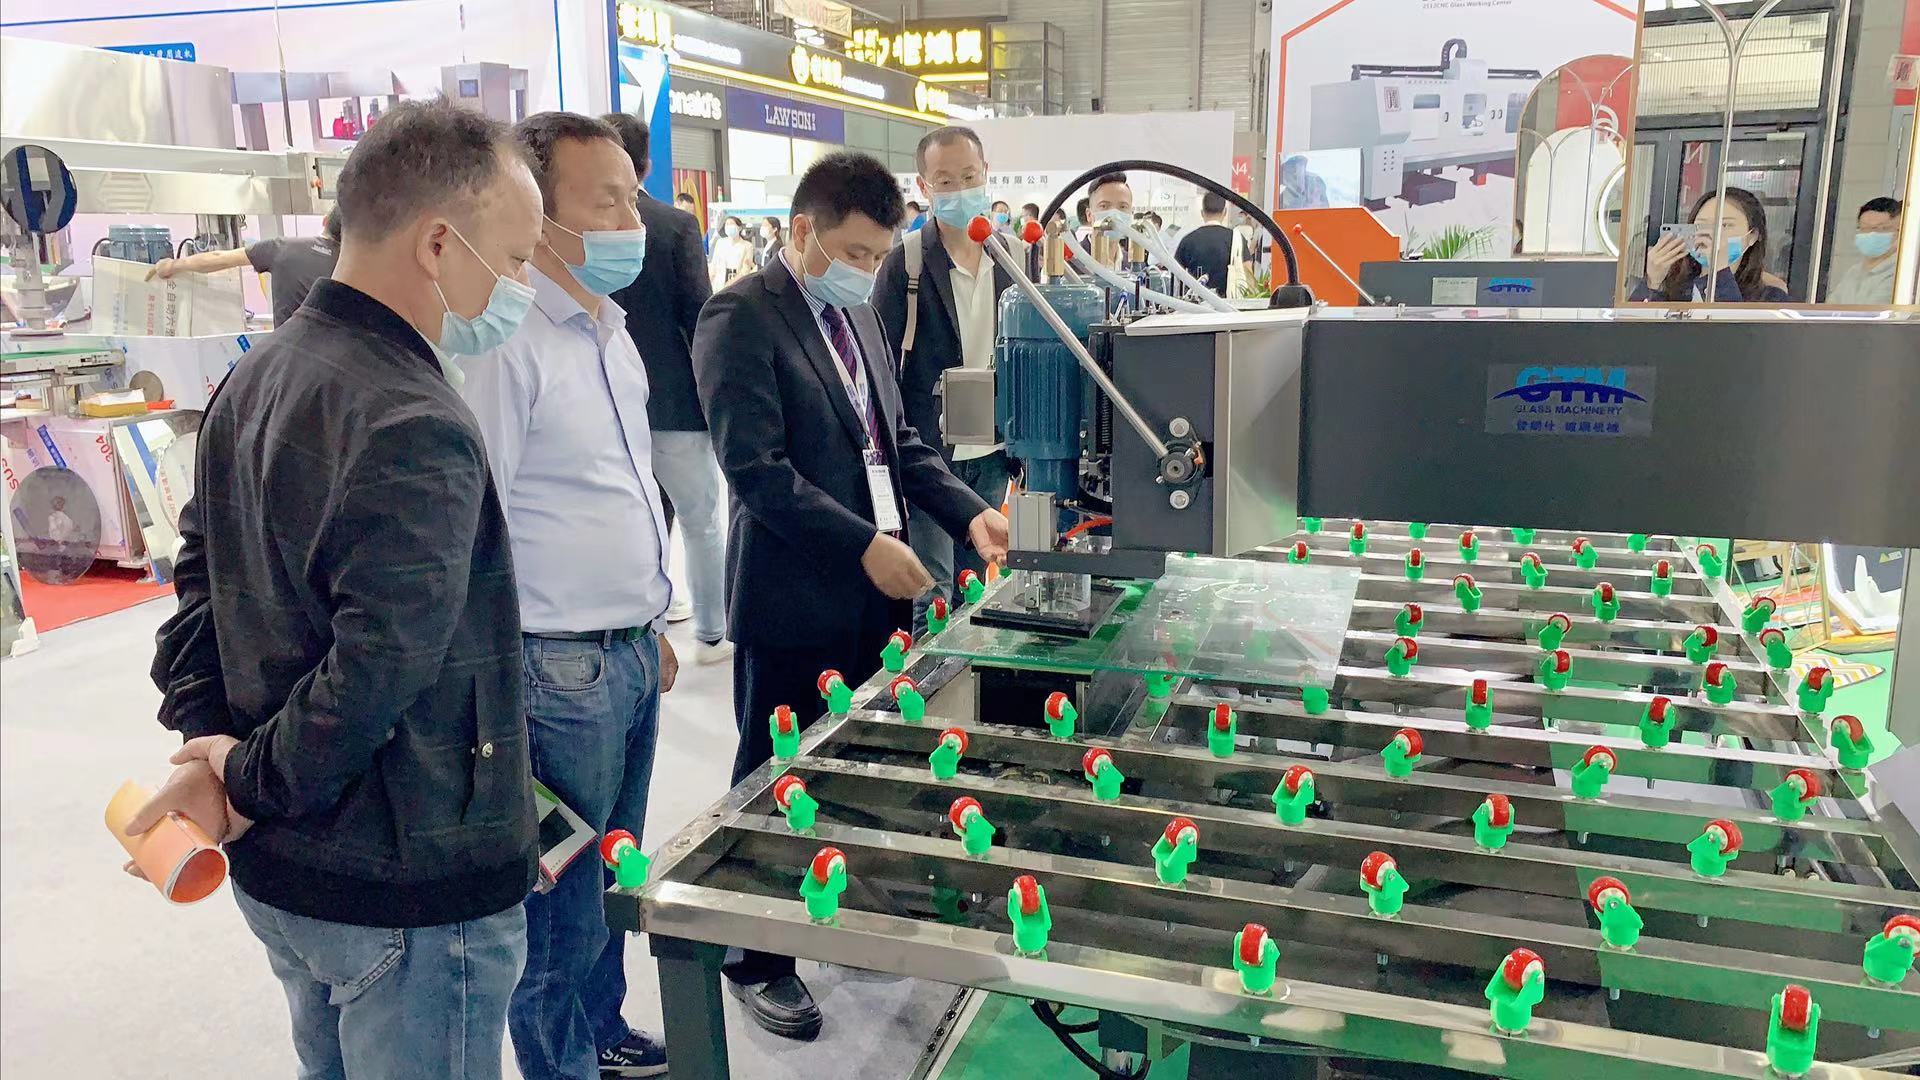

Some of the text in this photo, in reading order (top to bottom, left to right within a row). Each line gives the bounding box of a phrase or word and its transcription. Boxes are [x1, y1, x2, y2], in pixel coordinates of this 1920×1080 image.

[764, 104, 812, 131] LAWSON
[1515, 366, 1627, 403] GTM
[1514, 404, 1623, 415] GLASS MACHINERY
